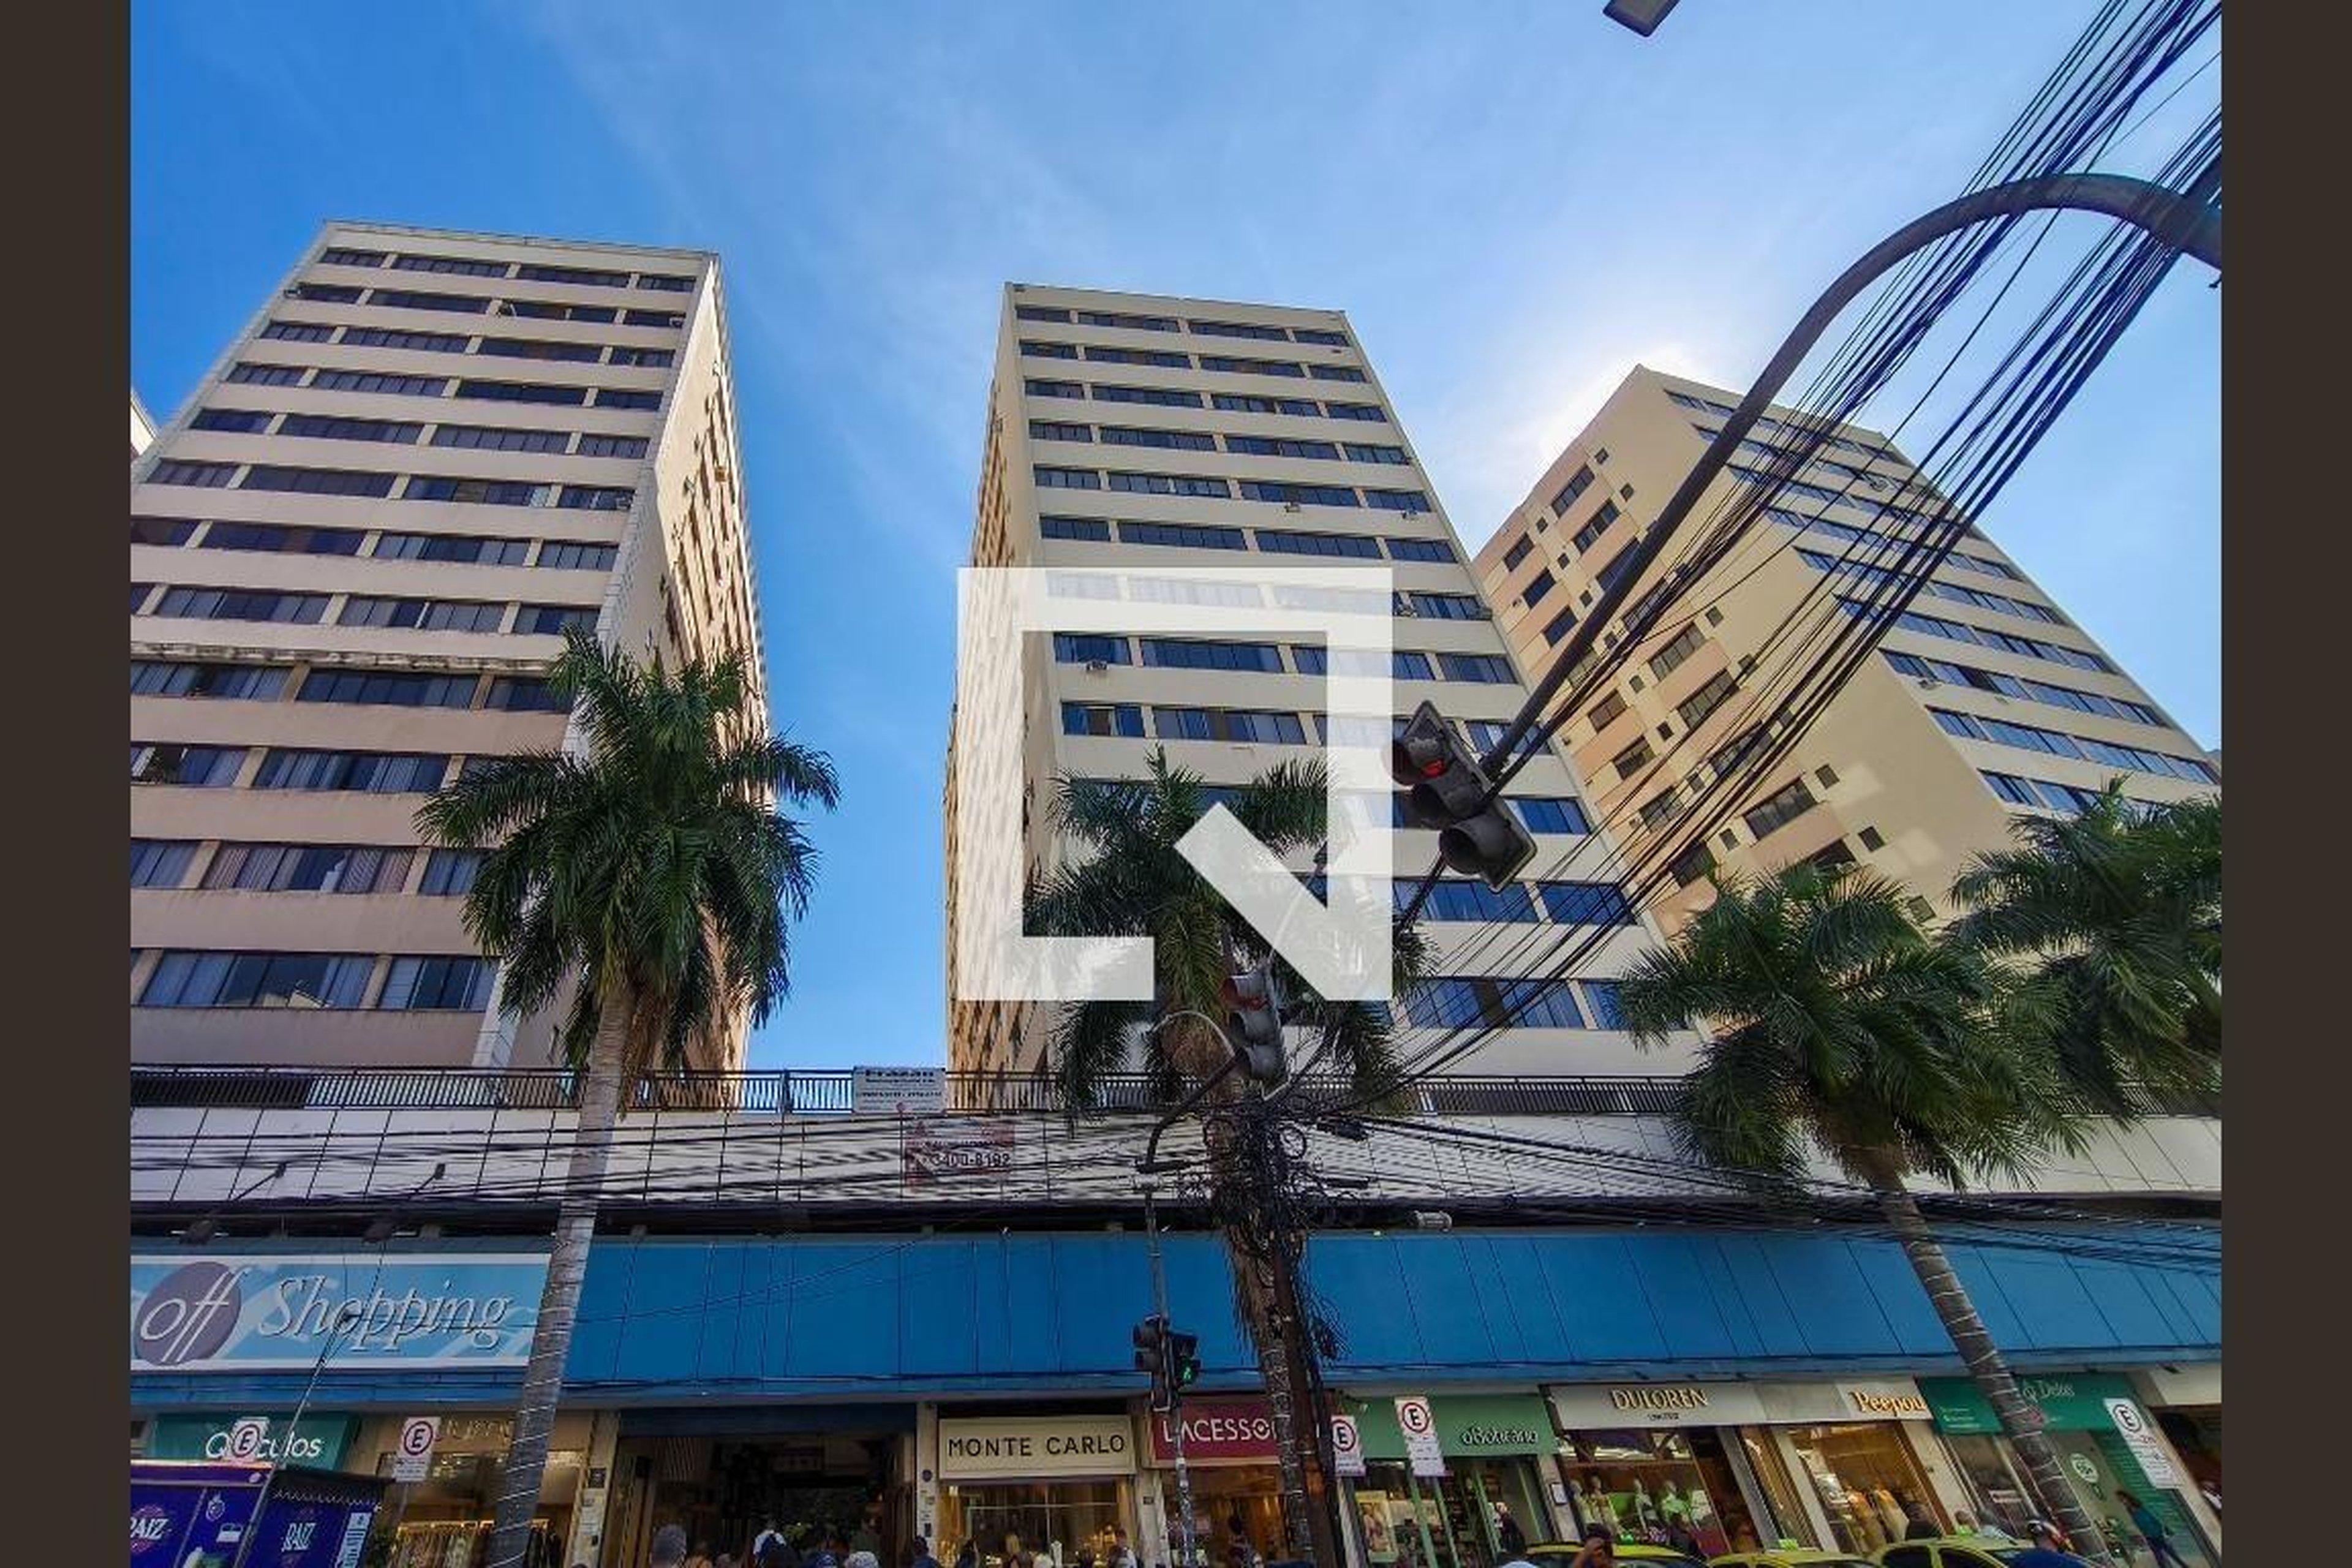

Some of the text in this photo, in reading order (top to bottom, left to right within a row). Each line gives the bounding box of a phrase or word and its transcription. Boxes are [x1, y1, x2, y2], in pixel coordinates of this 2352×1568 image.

[139, 1265, 514, 1362] off Shopping
[1408, 1408, 1422, 1427] E
[2120, 1409, 2136, 1428] E
[205, 1431, 324, 1458] Qculos
[238, 1431, 254, 1451] E
[411, 1428, 426, 1448] E
[1336, 1426, 1348, 1444] E
[948, 1434, 1126, 1458] MONTE CARLO
